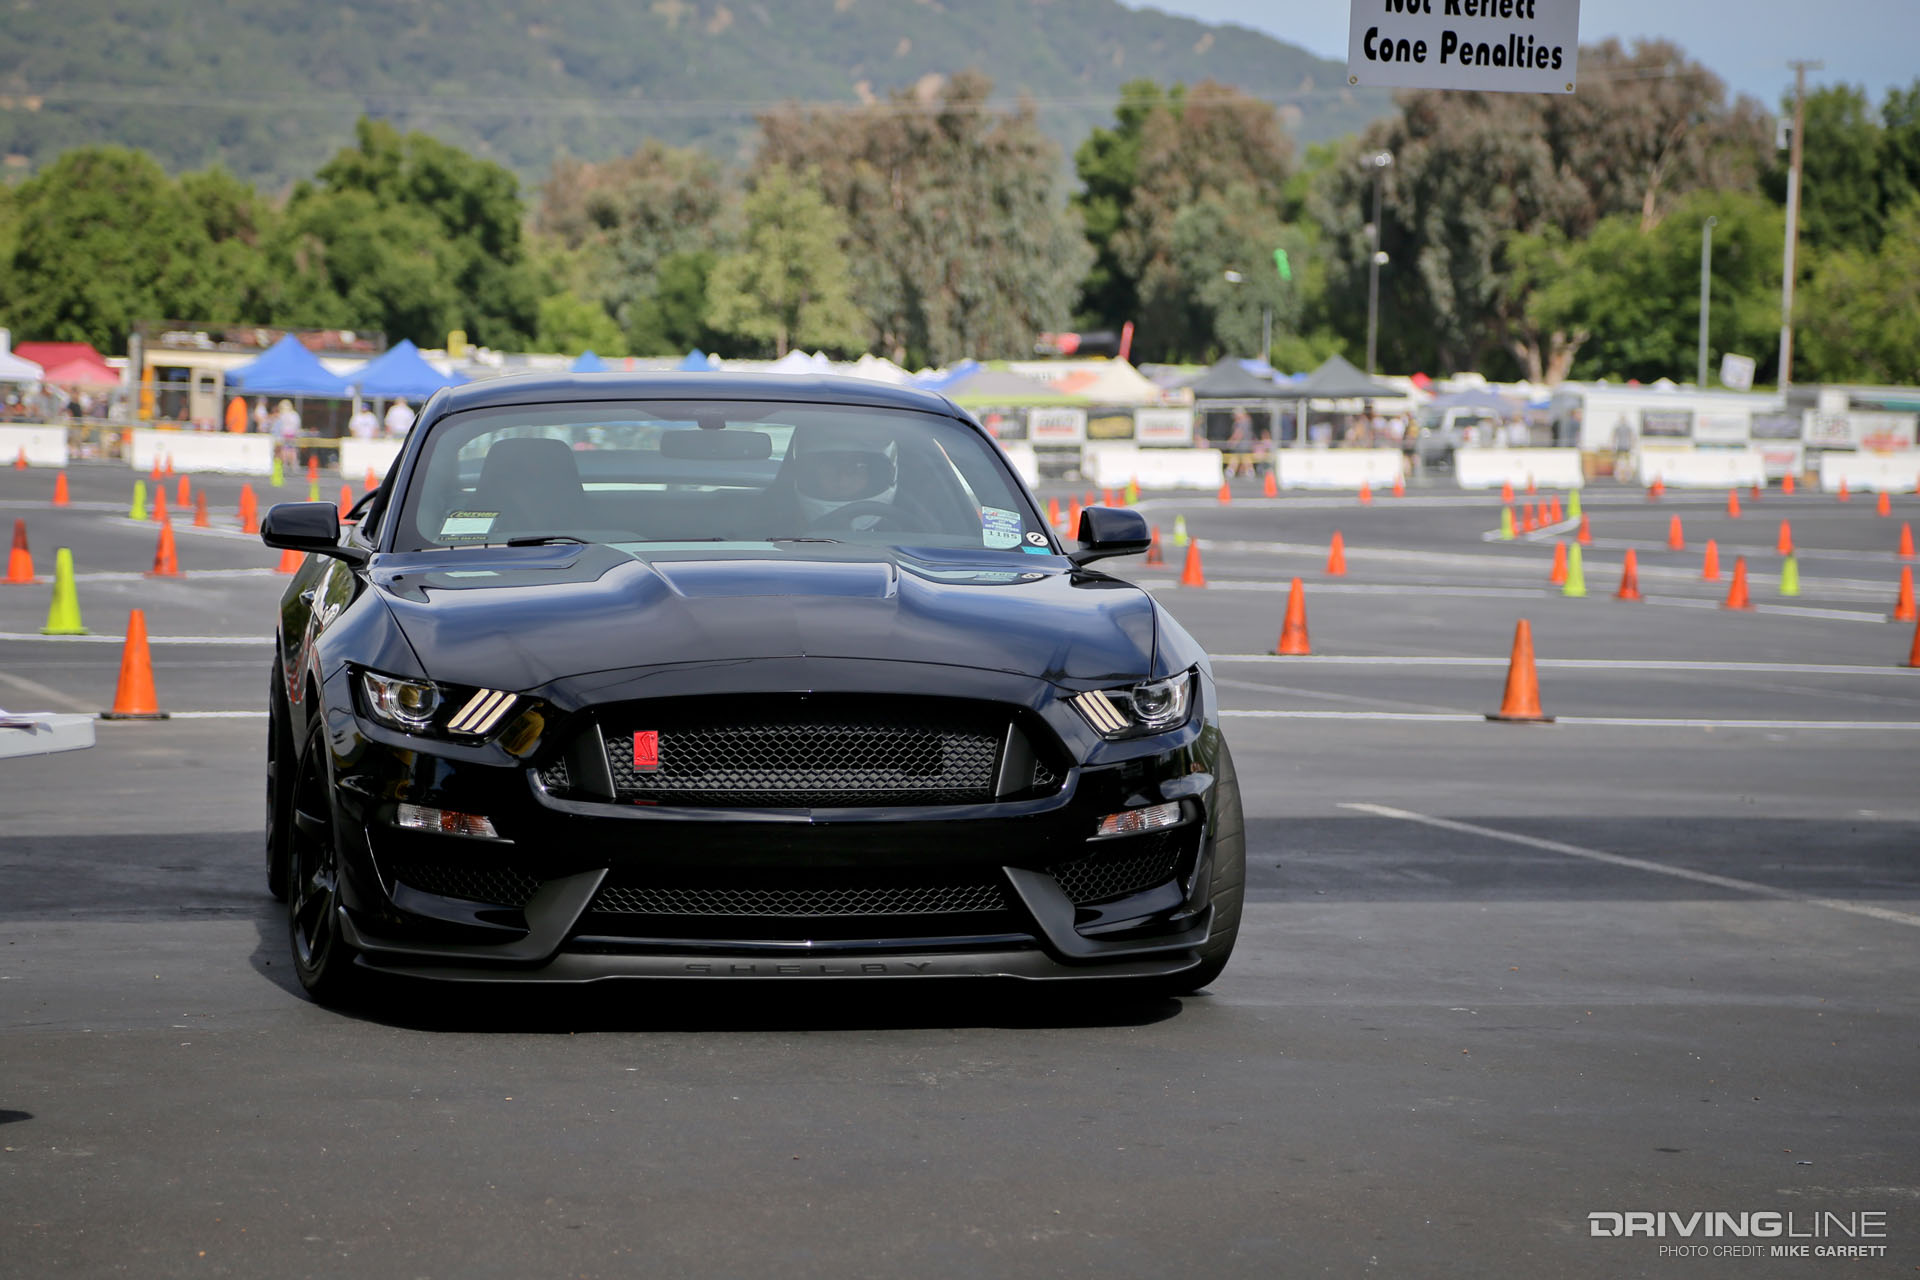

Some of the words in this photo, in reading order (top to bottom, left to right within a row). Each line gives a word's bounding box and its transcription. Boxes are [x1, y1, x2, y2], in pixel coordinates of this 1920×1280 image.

[1364, 27, 1427, 63] Cone
[1440, 30, 1562, 70] Penalties
[1031, 535, 1044, 543] 2
[685, 962, 931, 973] SHELBY
